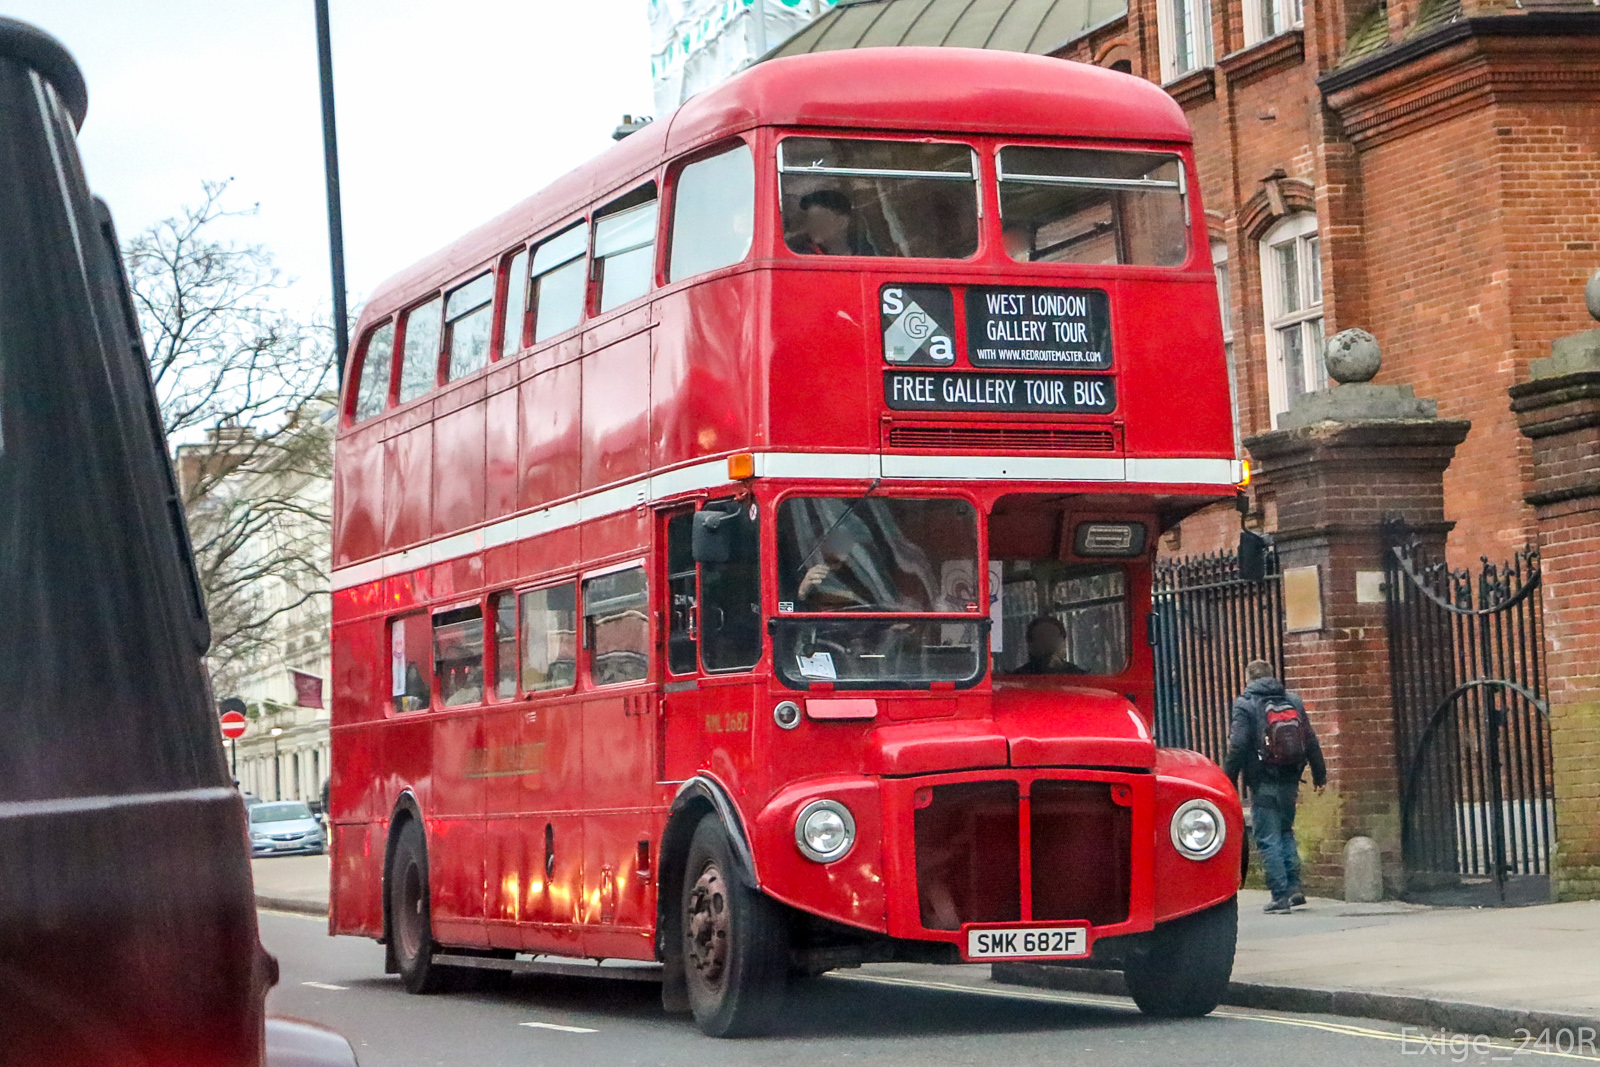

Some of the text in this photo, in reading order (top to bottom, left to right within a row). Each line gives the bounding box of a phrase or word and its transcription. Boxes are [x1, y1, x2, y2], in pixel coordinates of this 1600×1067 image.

[986, 294, 1086, 317] WEST LONDON
[883, 288, 954, 360] S G a
[986, 320, 1088, 343] GALLERY TOUR
[976, 348, 1102, 363] WITH WWW.REDROUTEMASTER.COM
[893, 376, 1106, 406] FREE GALLERY TOUR BUS
[977, 931, 1077, 953] SMK 682F
